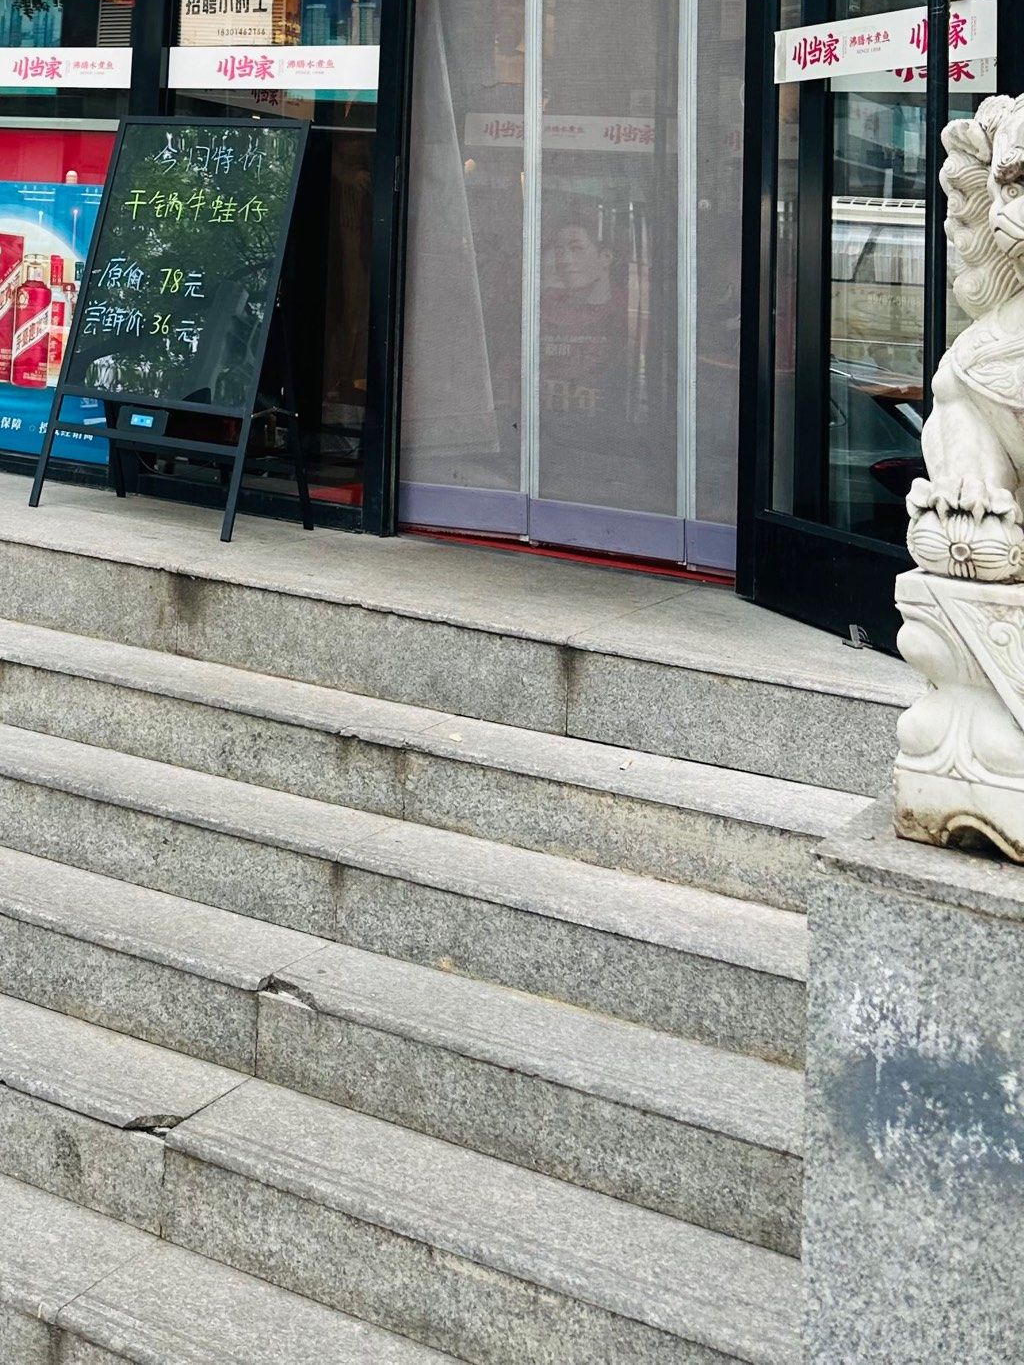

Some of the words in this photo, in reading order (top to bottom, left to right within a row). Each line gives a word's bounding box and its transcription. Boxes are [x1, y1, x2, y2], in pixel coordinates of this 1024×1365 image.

[910, 13, 967, 55] 川家
[13, 56, 62, 80] 川当家
[217, 55, 275, 81] 川当家
[792, 33, 840, 70] 川当家
[125, 189, 268, 223] 干锅牛蛙仔
